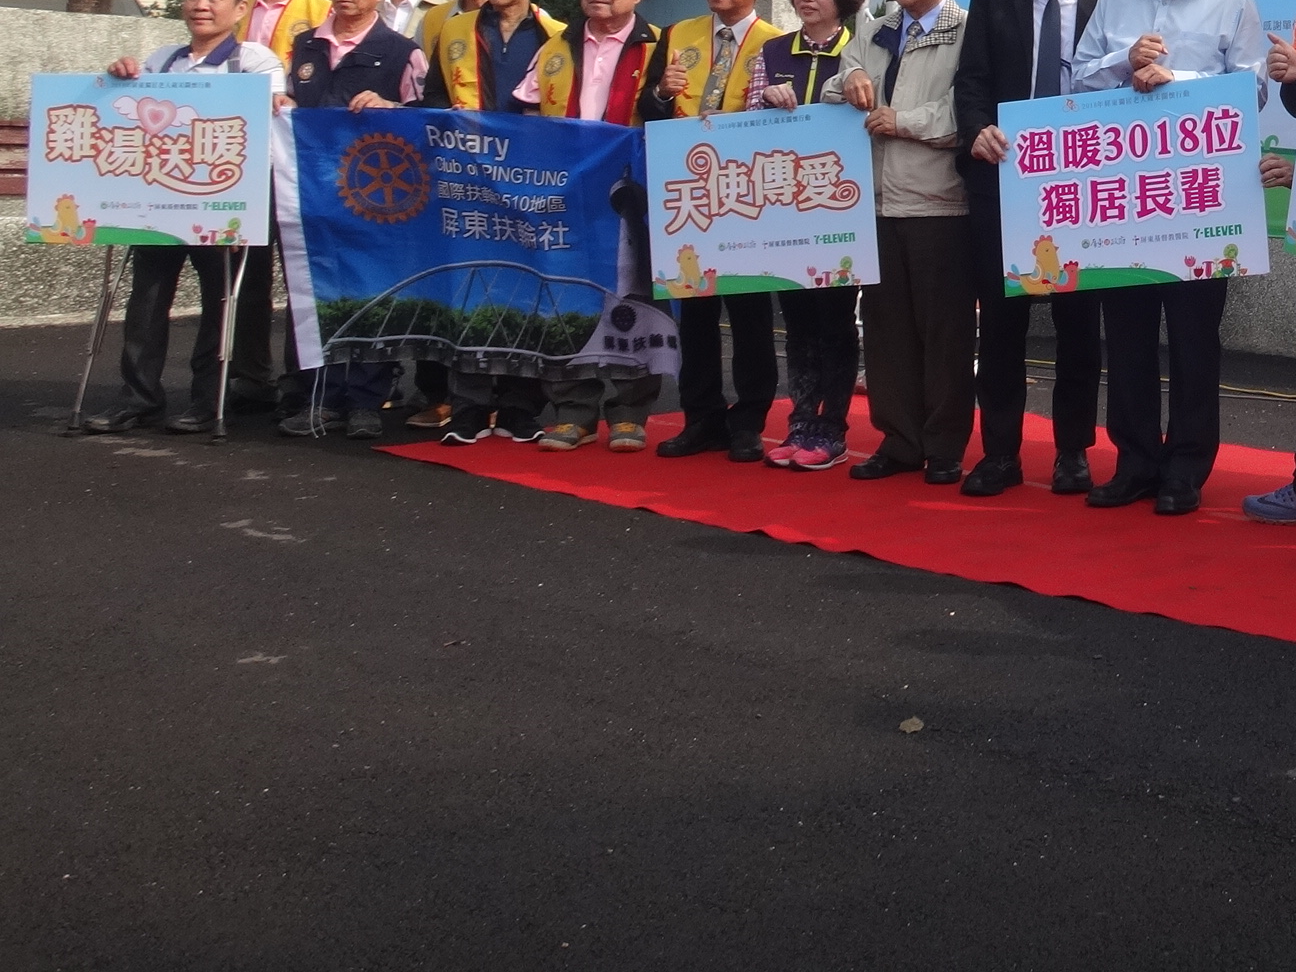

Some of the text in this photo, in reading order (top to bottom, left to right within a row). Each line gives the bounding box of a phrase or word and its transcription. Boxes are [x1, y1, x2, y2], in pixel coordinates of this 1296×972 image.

[45, 104, 248, 196] 雞湯送暖
[426, 125, 509, 161] Rotary
[435, 156, 462, 174] Club
[482, 164, 569, 187] PINGTUNG
[1016, 108, 1243, 175] 溫暖3018位
[664, 143, 860, 235] 天使傳愛
[1041, 166, 1223, 228] 獨居長輩
[441, 206, 571, 251] 屏東扶輪社
